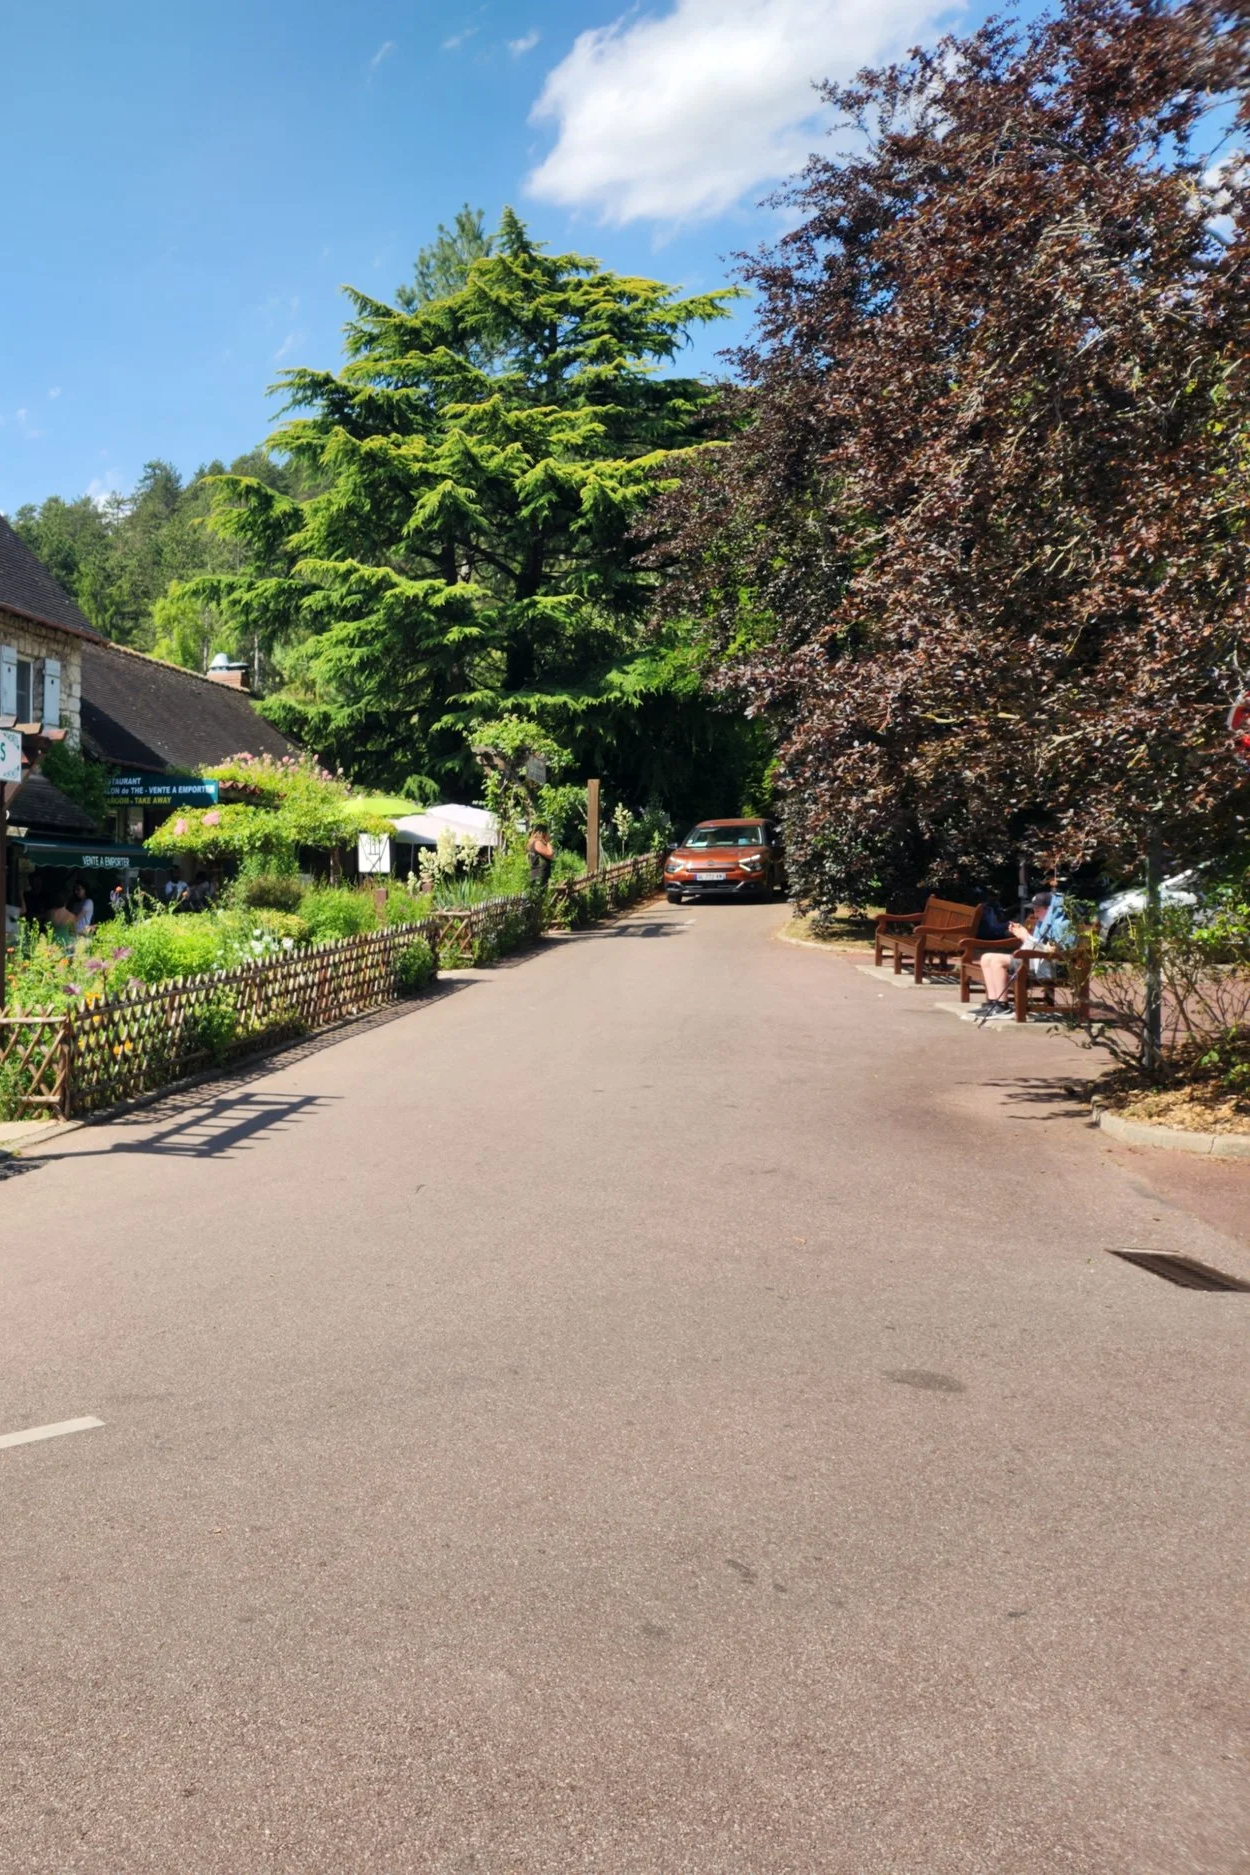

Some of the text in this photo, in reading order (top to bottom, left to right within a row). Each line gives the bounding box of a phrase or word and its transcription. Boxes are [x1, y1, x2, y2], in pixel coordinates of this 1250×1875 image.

[148, 785, 170, 795] VENTE
[135, 796, 151, 805] TAKE
[152, 796, 172, 805] AWAY
[82, 855, 99, 866] VENTE
[104, 856, 130, 867] EMPORTER
